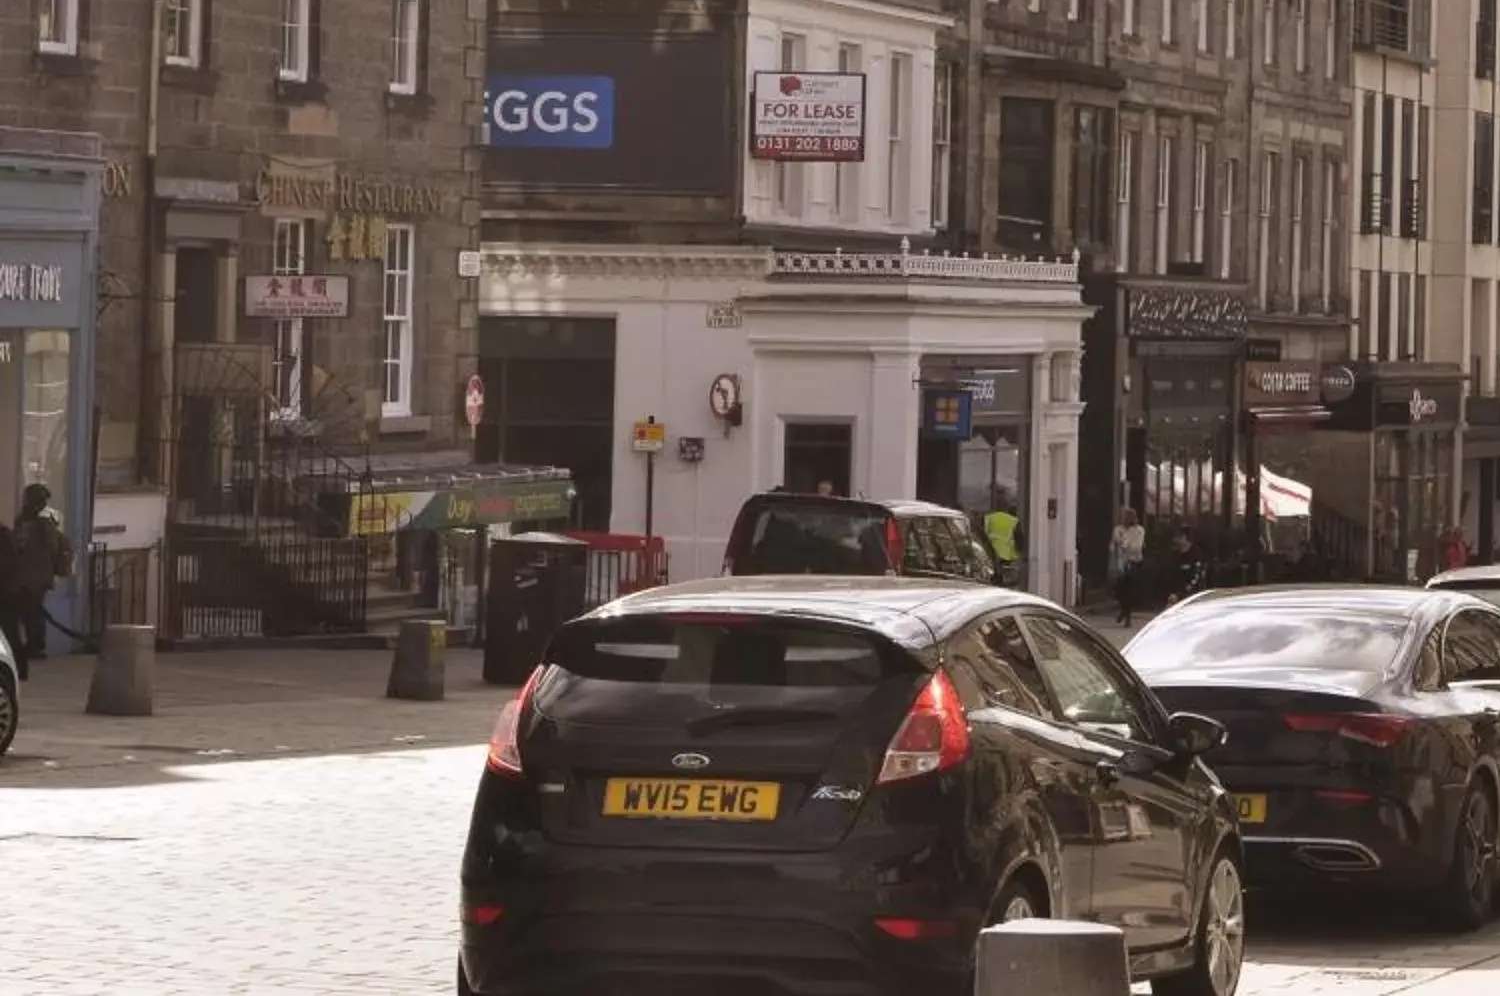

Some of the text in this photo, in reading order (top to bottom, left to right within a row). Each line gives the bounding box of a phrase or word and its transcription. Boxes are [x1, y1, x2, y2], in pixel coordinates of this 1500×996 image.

[763, 103, 856, 119] FOR LEASE
[757, 137, 790, 150] 0131
[795, 137, 821, 151] 202
[623, 782, 759, 813] WV15 EWG
